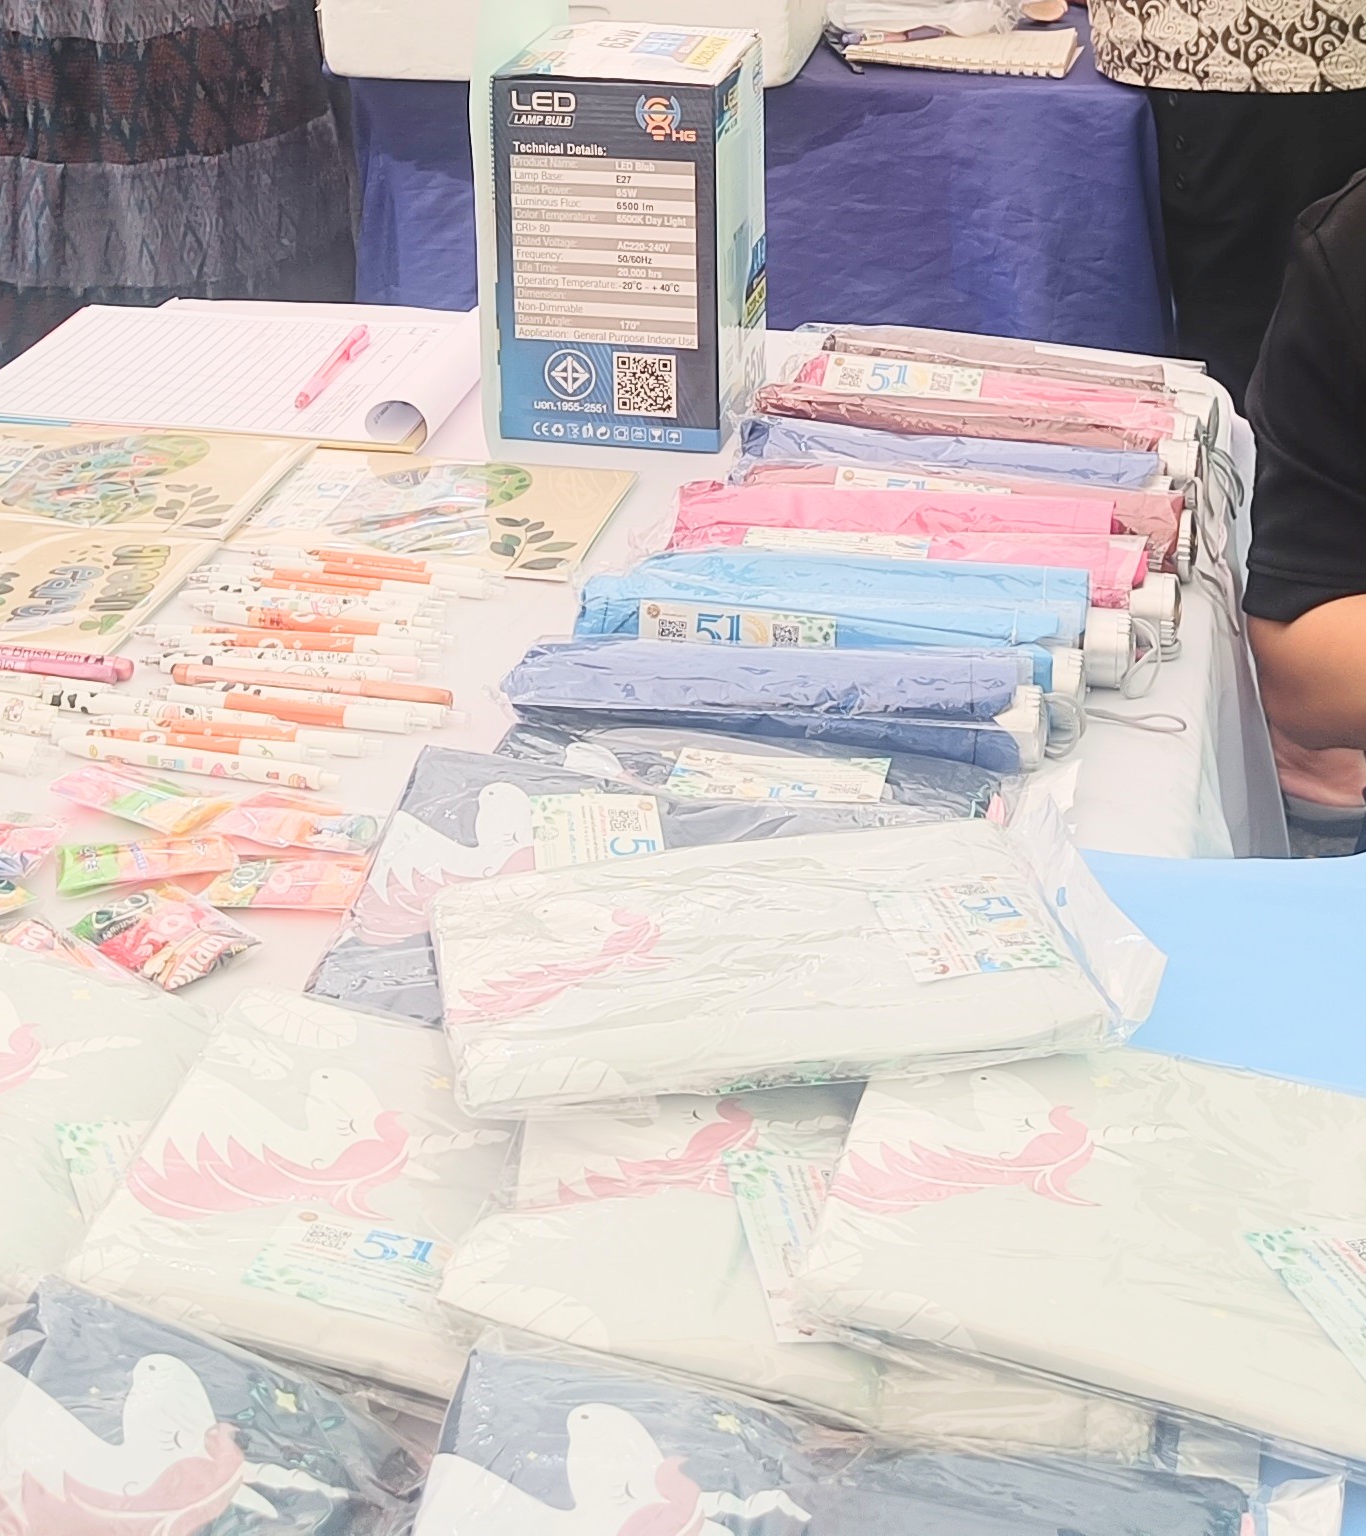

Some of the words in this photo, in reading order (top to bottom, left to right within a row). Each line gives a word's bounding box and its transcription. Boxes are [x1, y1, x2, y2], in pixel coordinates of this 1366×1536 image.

[511, 90, 576, 112] LED
[514, 115, 543, 125] LAMP
[545, 116, 572, 126] BULB
[672, 130, 696, 141] HG
[513, 141, 564, 154] Technical
[566, 143, 607, 156] Details:
[513, 157, 549, 168] Product
[615, 162, 633, 171] LED
[514, 171, 538, 181] Lamp
[541, 171, 563, 180] Base:
[616, 175, 631, 184] E27
[514, 184, 539, 194] Rated
[616, 188, 638, 197] 65W
[515, 197, 559, 207] Luminous
[560, 198, 580, 207] Flux:
[617, 202, 639, 210] 6500
[643, 203, 654, 211] lm
[515, 209, 537, 219] Color
[541, 210, 597, 223] Temperature:
[616, 215, 644, 224] 6500K
[645, 216, 662, 227] Day
[664, 216, 686, 227] Light
[539, 223, 550, 232] 80
[515, 236, 541, 246] Rated
[543, 237, 578, 249] Voltage:
[617, 241, 671, 253] AC220-240V
[516, 249, 563, 261] Frequency:
[617, 255, 652, 265] 50/60Hz
[516, 262, 533, 272] Life
[648, 269, 662, 279] hrs
[517, 275, 559, 288] Operating
[562, 277, 617, 289] Temperature:
[517, 289, 566, 299] Dimension:
[518, 302, 583, 313] Non-Dimmable
[518, 315, 543, 325] Beam
[544, 316, 572, 327] Angle:
[519, 327, 569, 339] Application:
[574, 329, 607, 340] General
[609, 333, 645, 344] Purpose
[647, 334, 676, 344] Indoor
[679, 336, 695, 346] Use
[866, 363, 908, 391] 51
[696, 612, 742, 644] 51
[57, 651, 83, 664] Pen
[959, 895, 1023, 922] 51
[354, 1229, 434, 1263] 51
